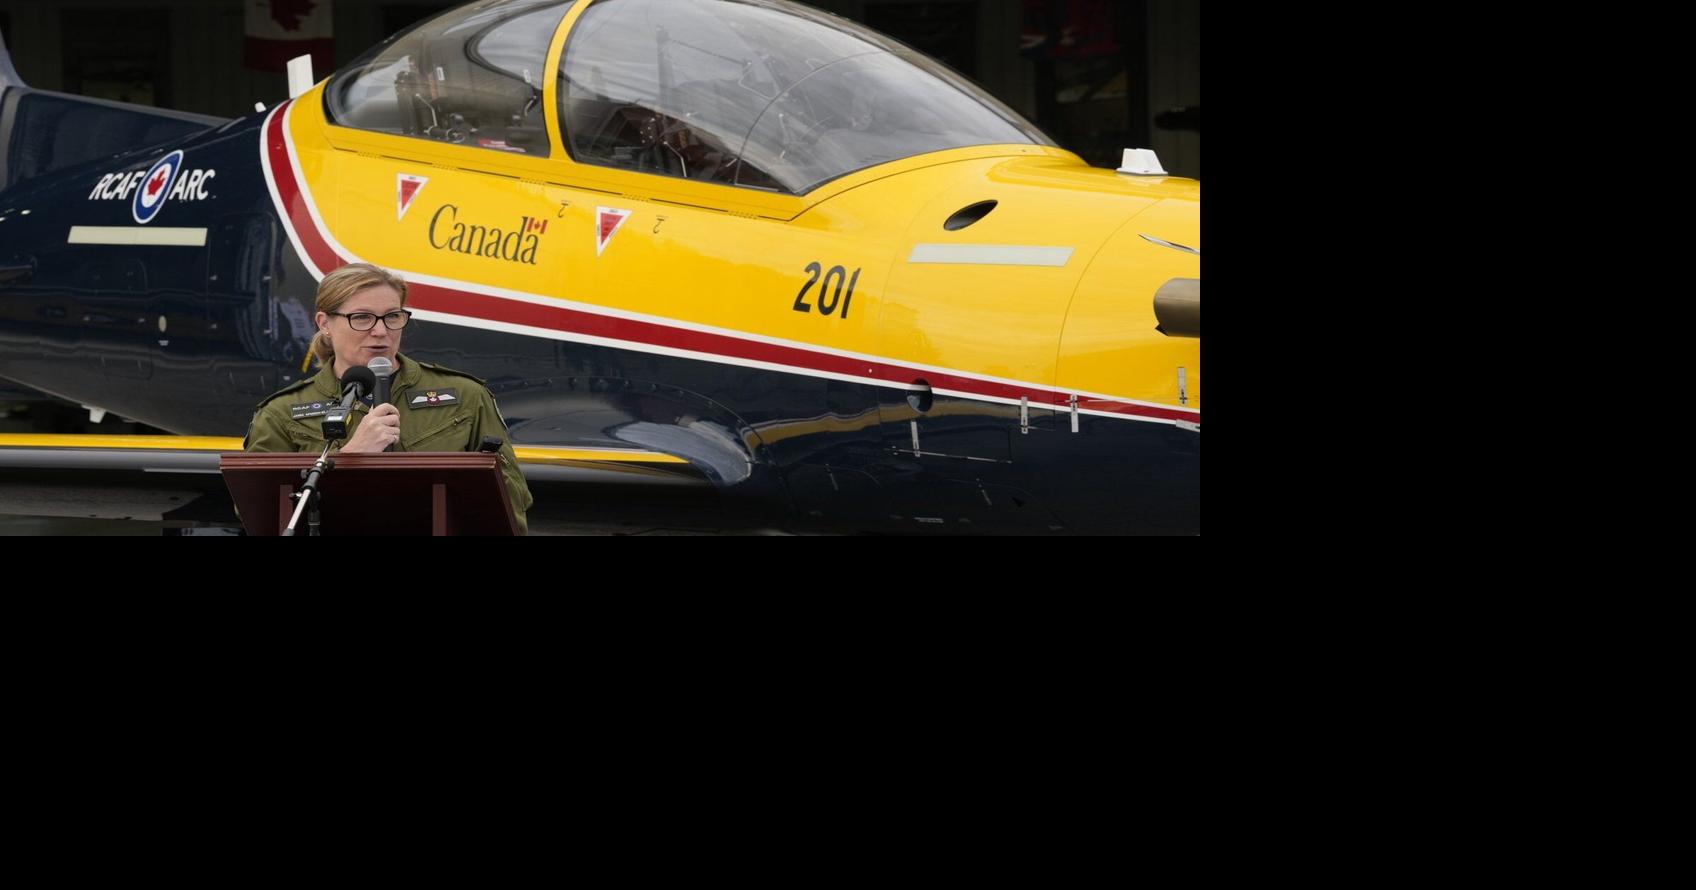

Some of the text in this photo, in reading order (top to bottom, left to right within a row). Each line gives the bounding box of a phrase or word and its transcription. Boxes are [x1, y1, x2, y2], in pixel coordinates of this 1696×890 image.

[88, 168, 216, 201] RCAF ARC
[428, 204, 539, 265] Canada
[792, 261, 861, 319] 201
